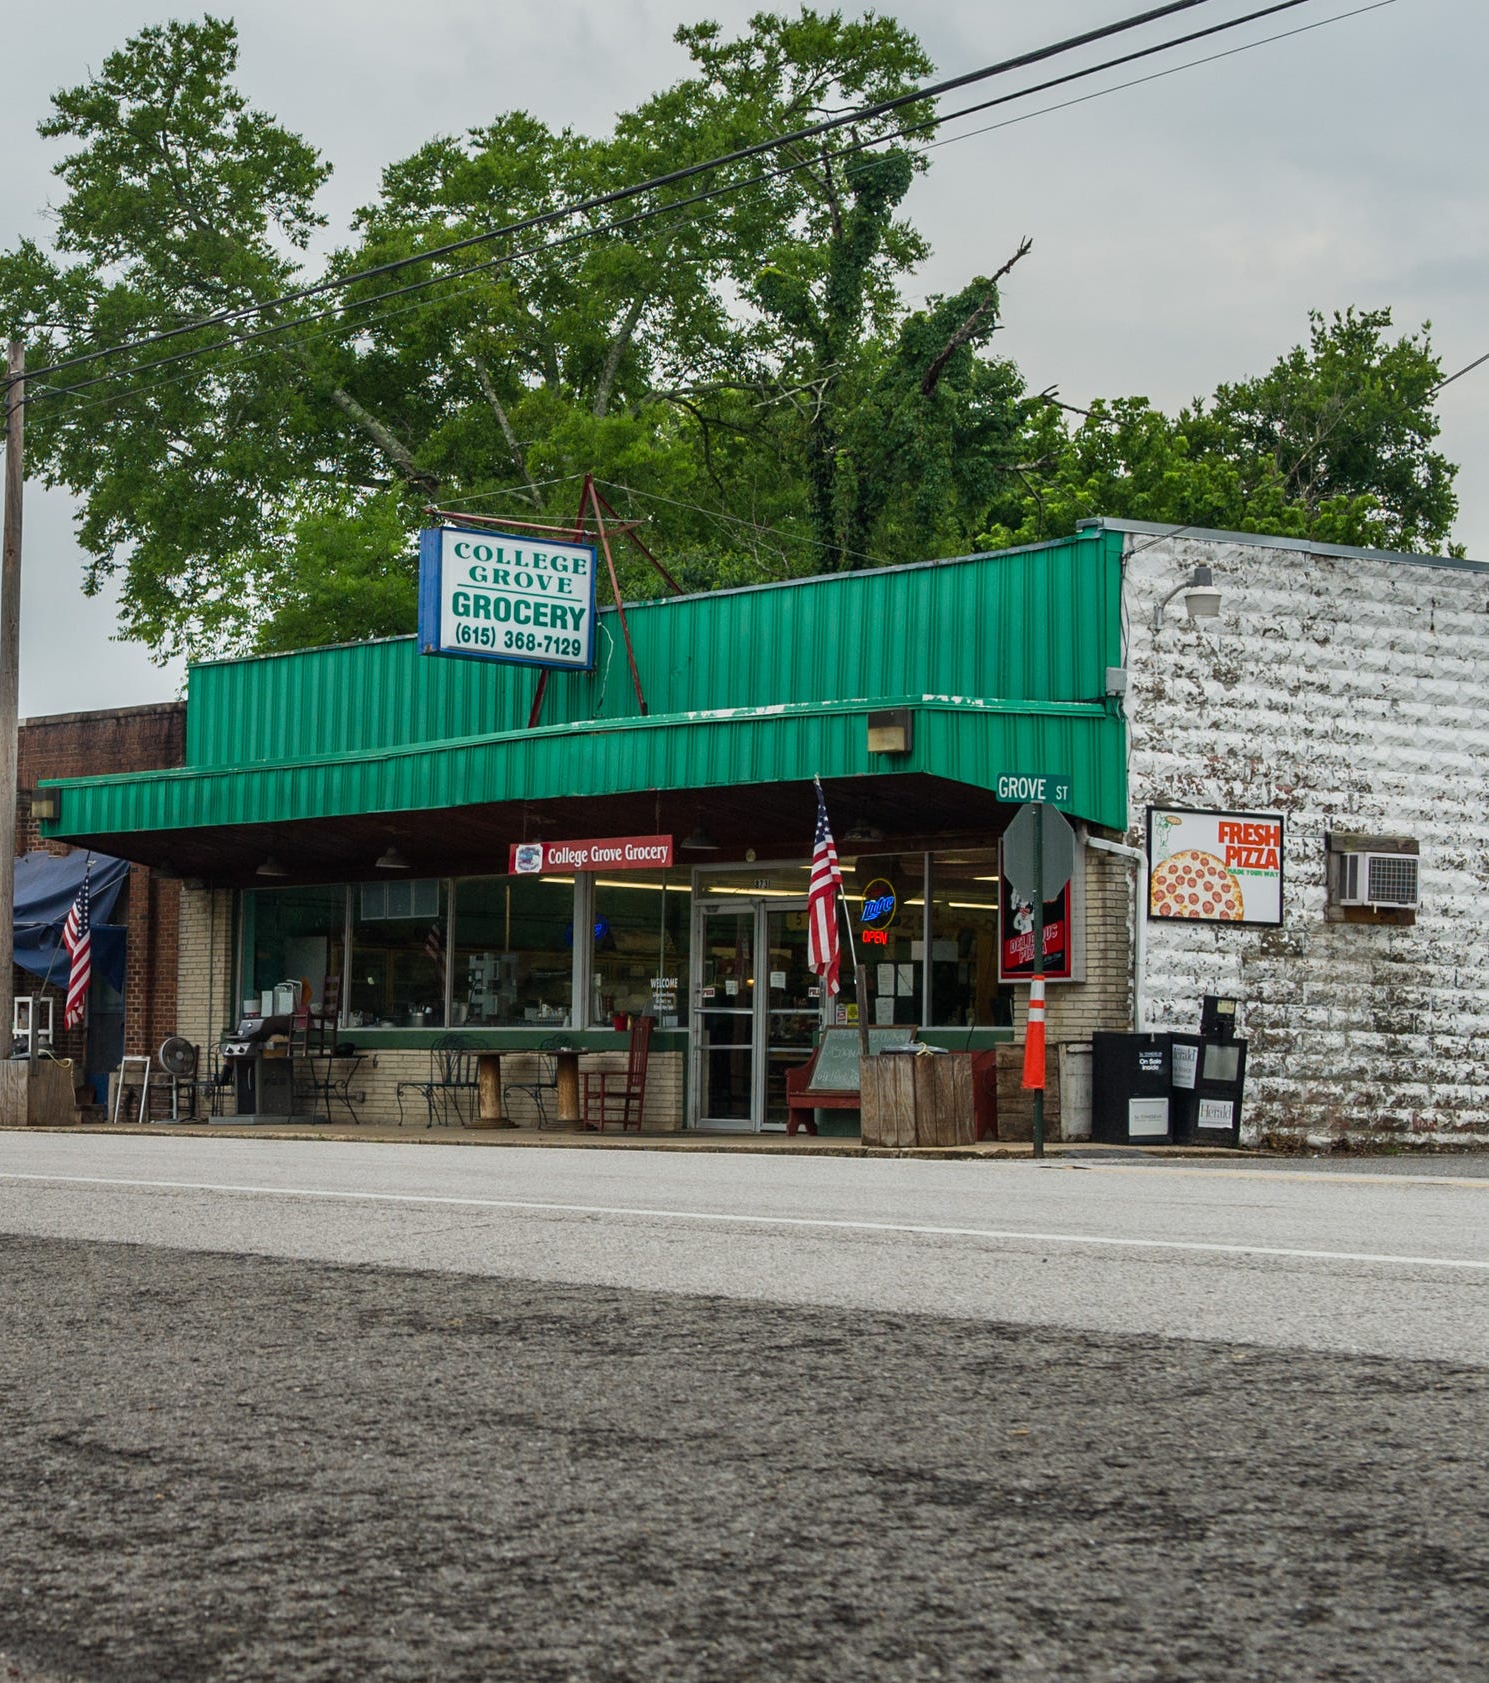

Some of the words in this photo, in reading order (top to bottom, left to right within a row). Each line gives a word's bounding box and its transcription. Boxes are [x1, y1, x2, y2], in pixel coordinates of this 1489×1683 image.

[454, 542, 587, 575] COLLEGE
[469, 565, 573, 594] GROVE
[452, 591, 586, 632] GROCERY
[456, 622, 496, 648] (615)
[504, 630, 582, 657] 368-7129
[998, 776, 1047, 800] GROVE
[1056, 785, 1068, 800] ST
[1218, 821, 1280, 847] FRESH
[547, 848, 588, 868] College
[590, 845, 622, 863] Grove
[625, 844, 669, 863] Grocery
[1225, 845, 1280, 870] PIZZA
[1264, 870, 1279, 878] WAY
[862, 930, 888, 945] OPEN
[1019, 941, 1047, 964] PIZ
[650, 977, 678, 988] WELCOME
[1200, 1103, 1232, 1120] Herald
